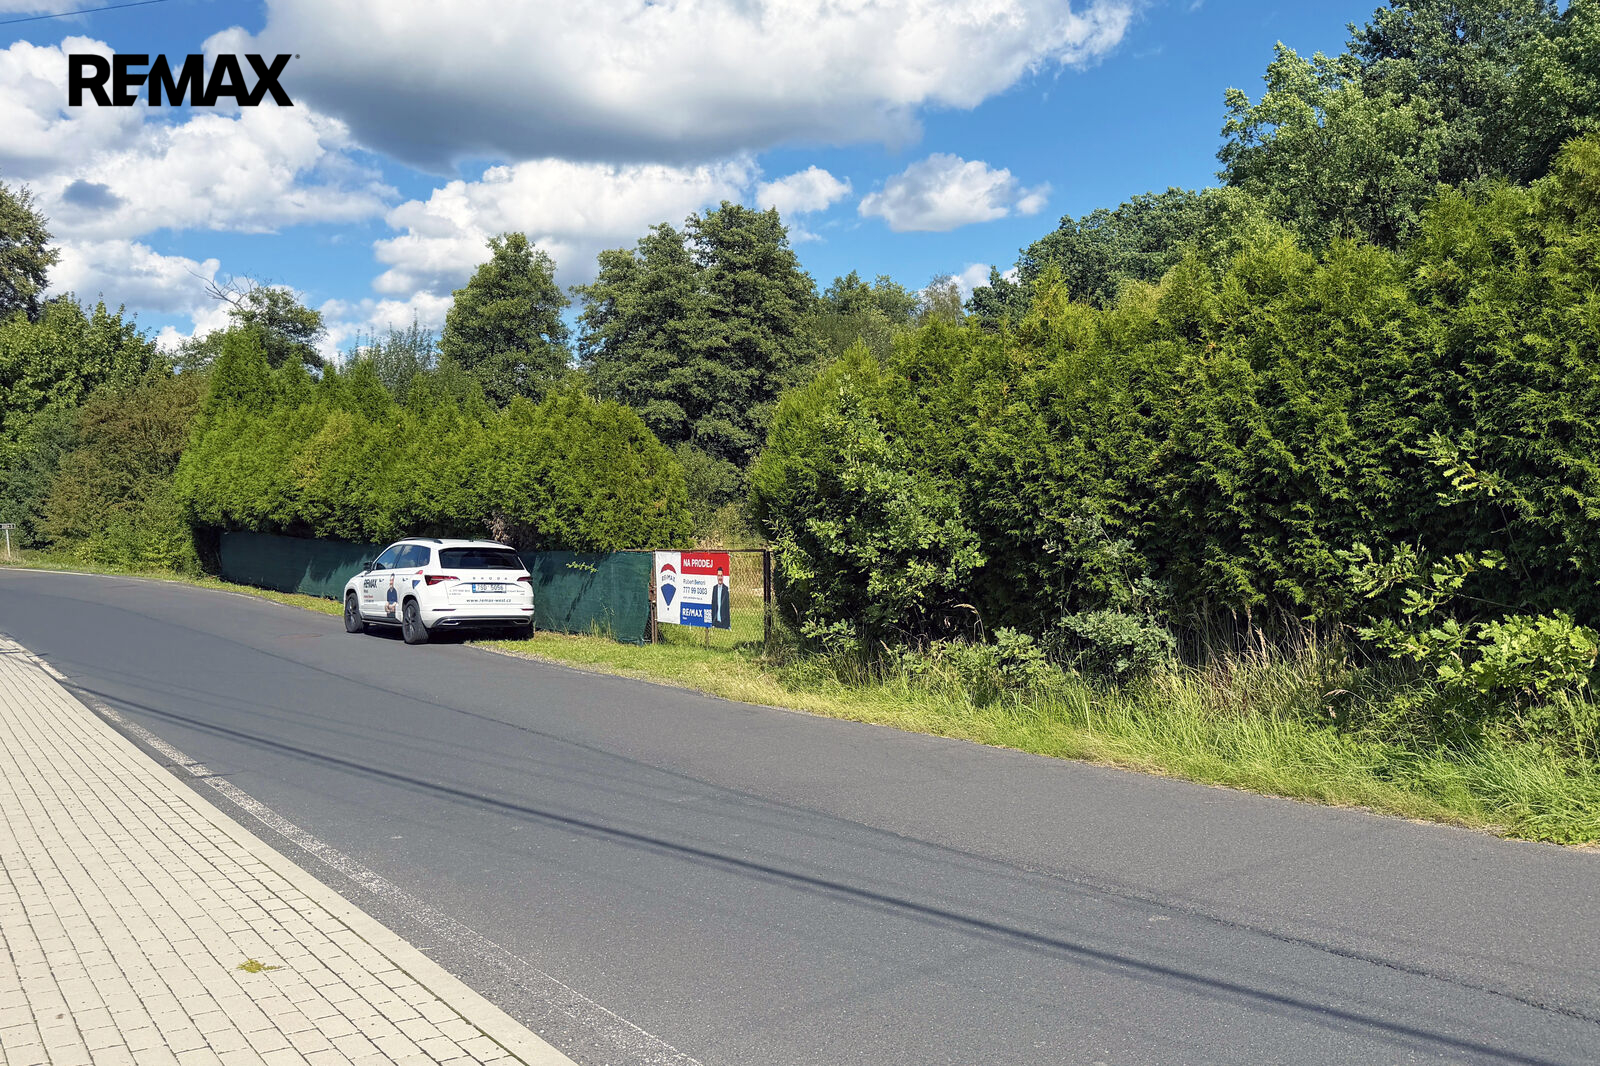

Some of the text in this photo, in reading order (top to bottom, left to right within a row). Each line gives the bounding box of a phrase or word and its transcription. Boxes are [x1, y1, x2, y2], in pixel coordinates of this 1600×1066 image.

[683, 559, 713, 568] NA PRODEJ
[683, 586, 691, 594] 777
